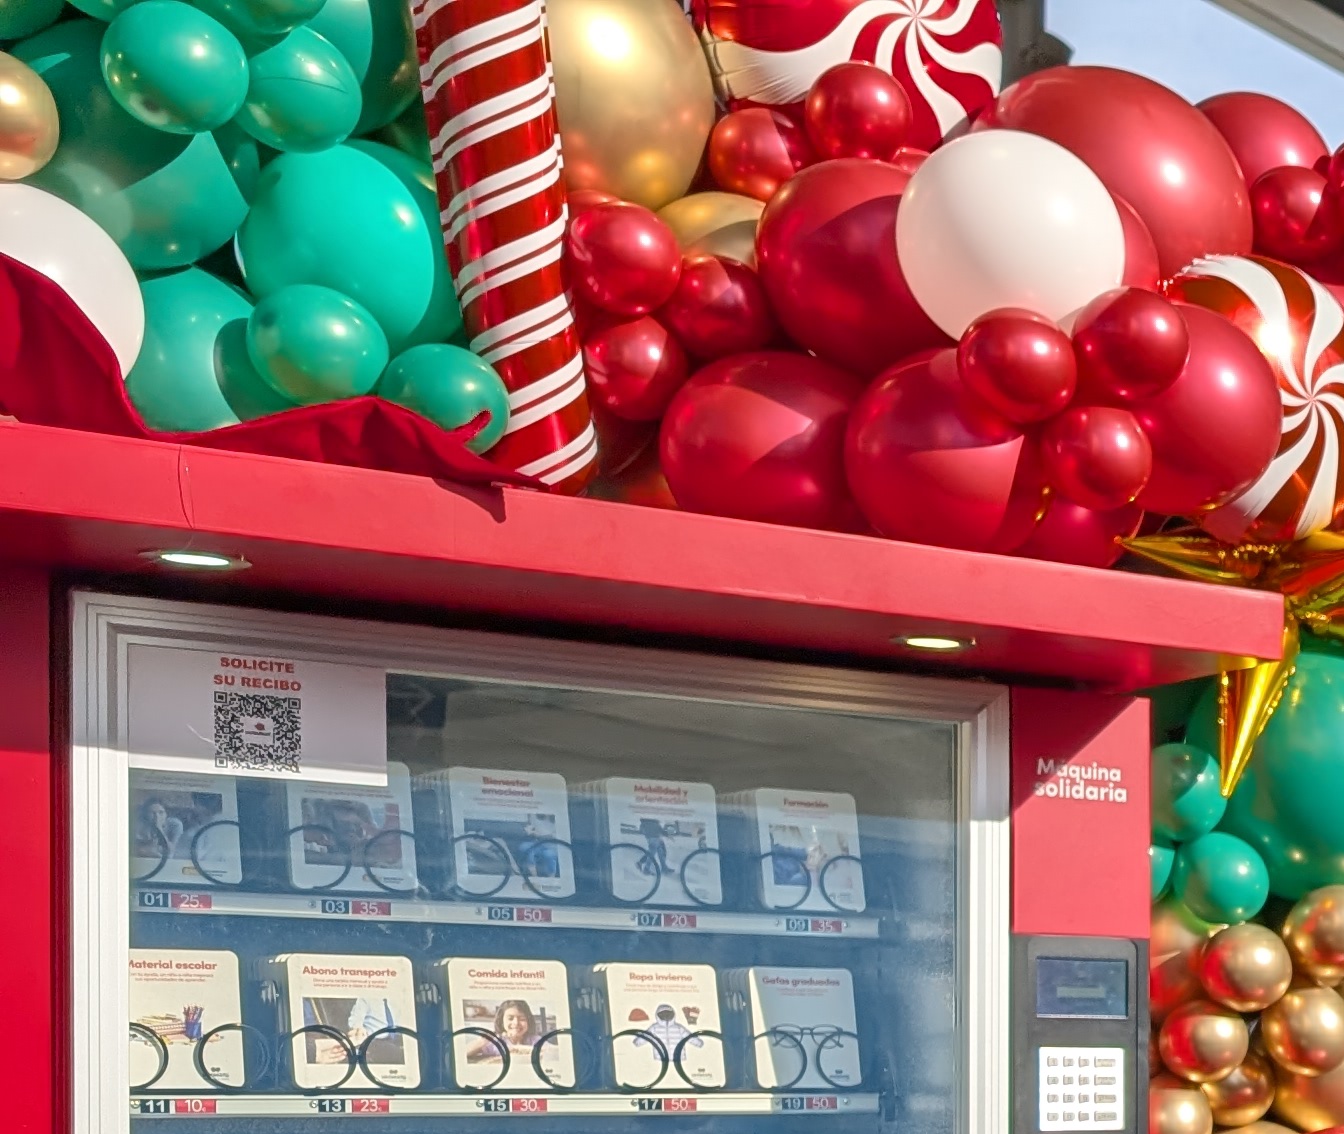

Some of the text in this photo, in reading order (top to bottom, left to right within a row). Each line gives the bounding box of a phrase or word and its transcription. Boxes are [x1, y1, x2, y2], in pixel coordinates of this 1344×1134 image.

[220, 656, 295, 674] SOLICITE
[213, 674, 302, 692] SU RECIBO
[1037, 757, 1121, 782] Máquina
[1034, 778, 1127, 802] solidaria
[144, 893, 164, 906] 01
[325, 901, 345, 914] 03
[491, 908, 510, 920] 05
[642, 914, 658, 926] 07
[175, 961, 217, 971] escolar
[302, 965, 397, 979] Abono transporte
[468, 968, 545, 980] Comida infantil
[145, 1100, 164, 1112] 11
[323, 1099, 342, 1112] 13
[490, 1099, 507, 1111] 15
[642, 1099, 658, 1111] 17
[786, 1099, 800, 1110] 19
